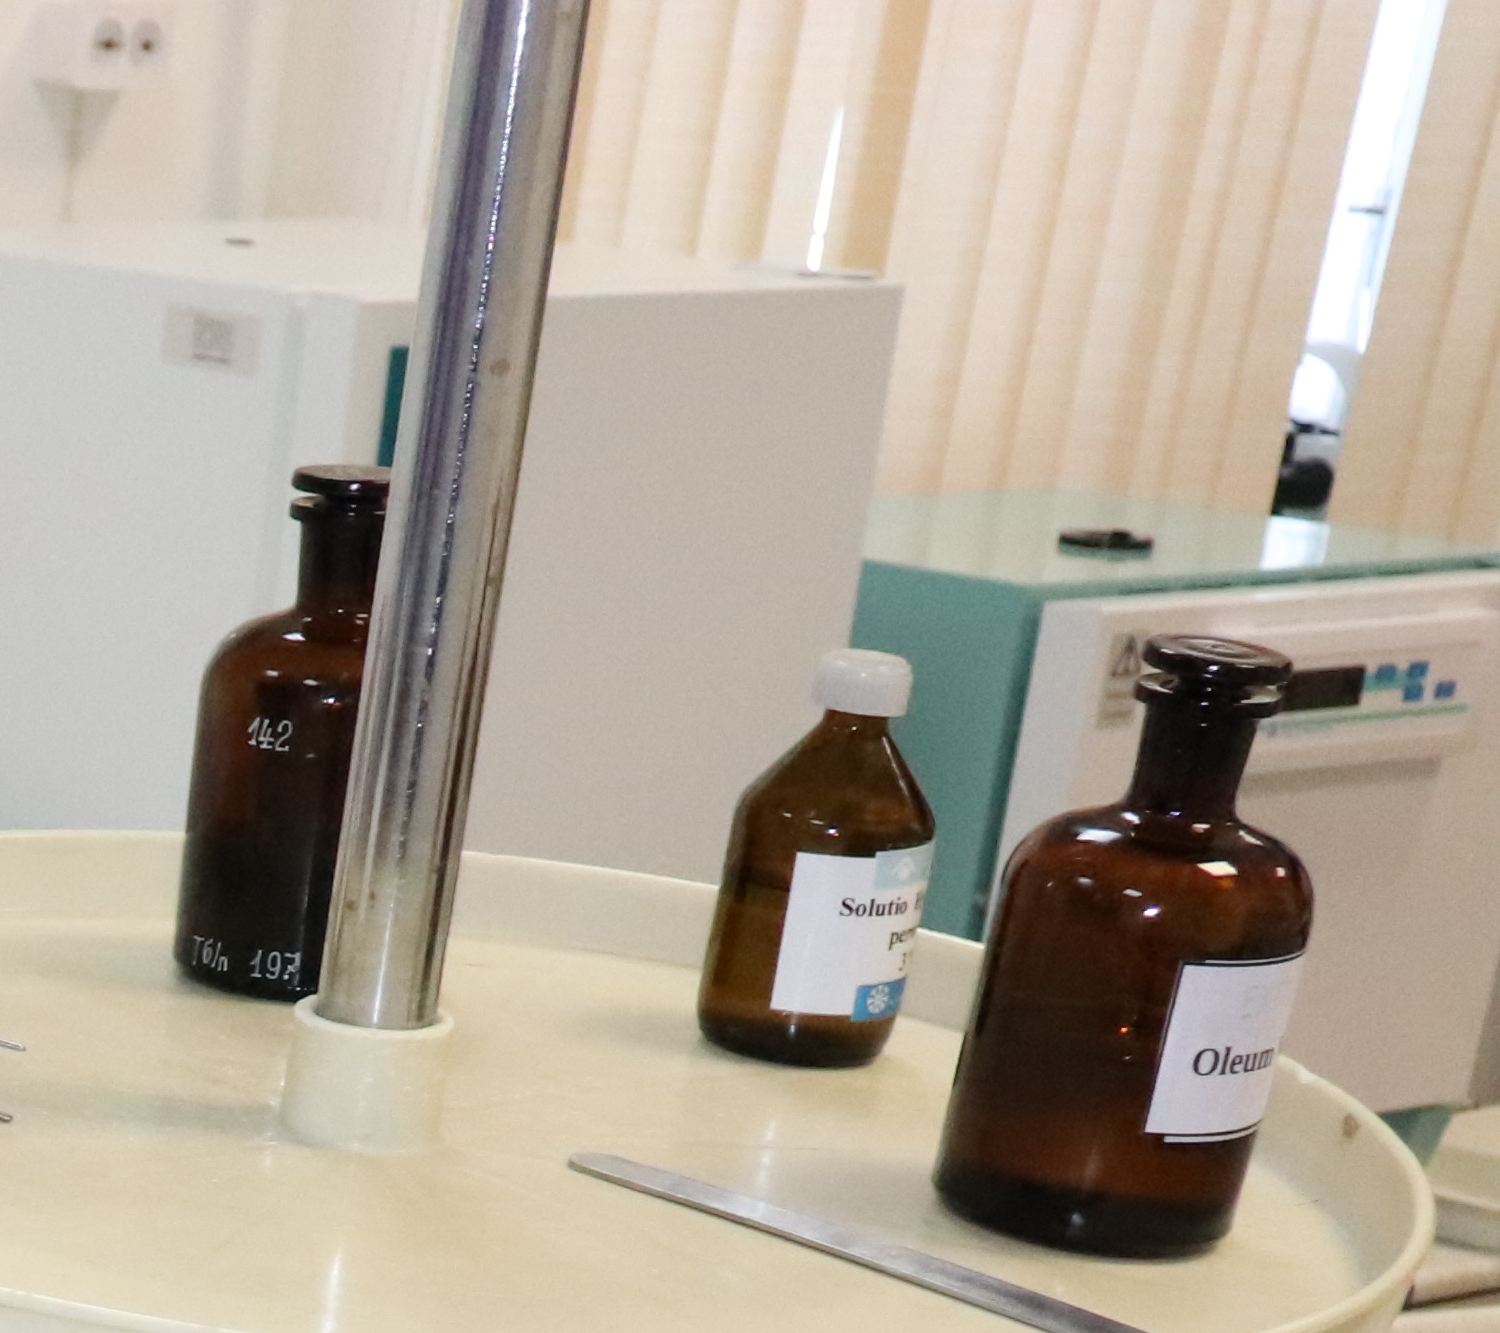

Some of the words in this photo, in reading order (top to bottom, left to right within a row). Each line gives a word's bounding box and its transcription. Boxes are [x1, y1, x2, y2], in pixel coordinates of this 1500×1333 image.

[246, 716, 294, 752] 142
[839, 897, 908, 917] Solutio
[1192, 1045, 1275, 1076] Oleum
